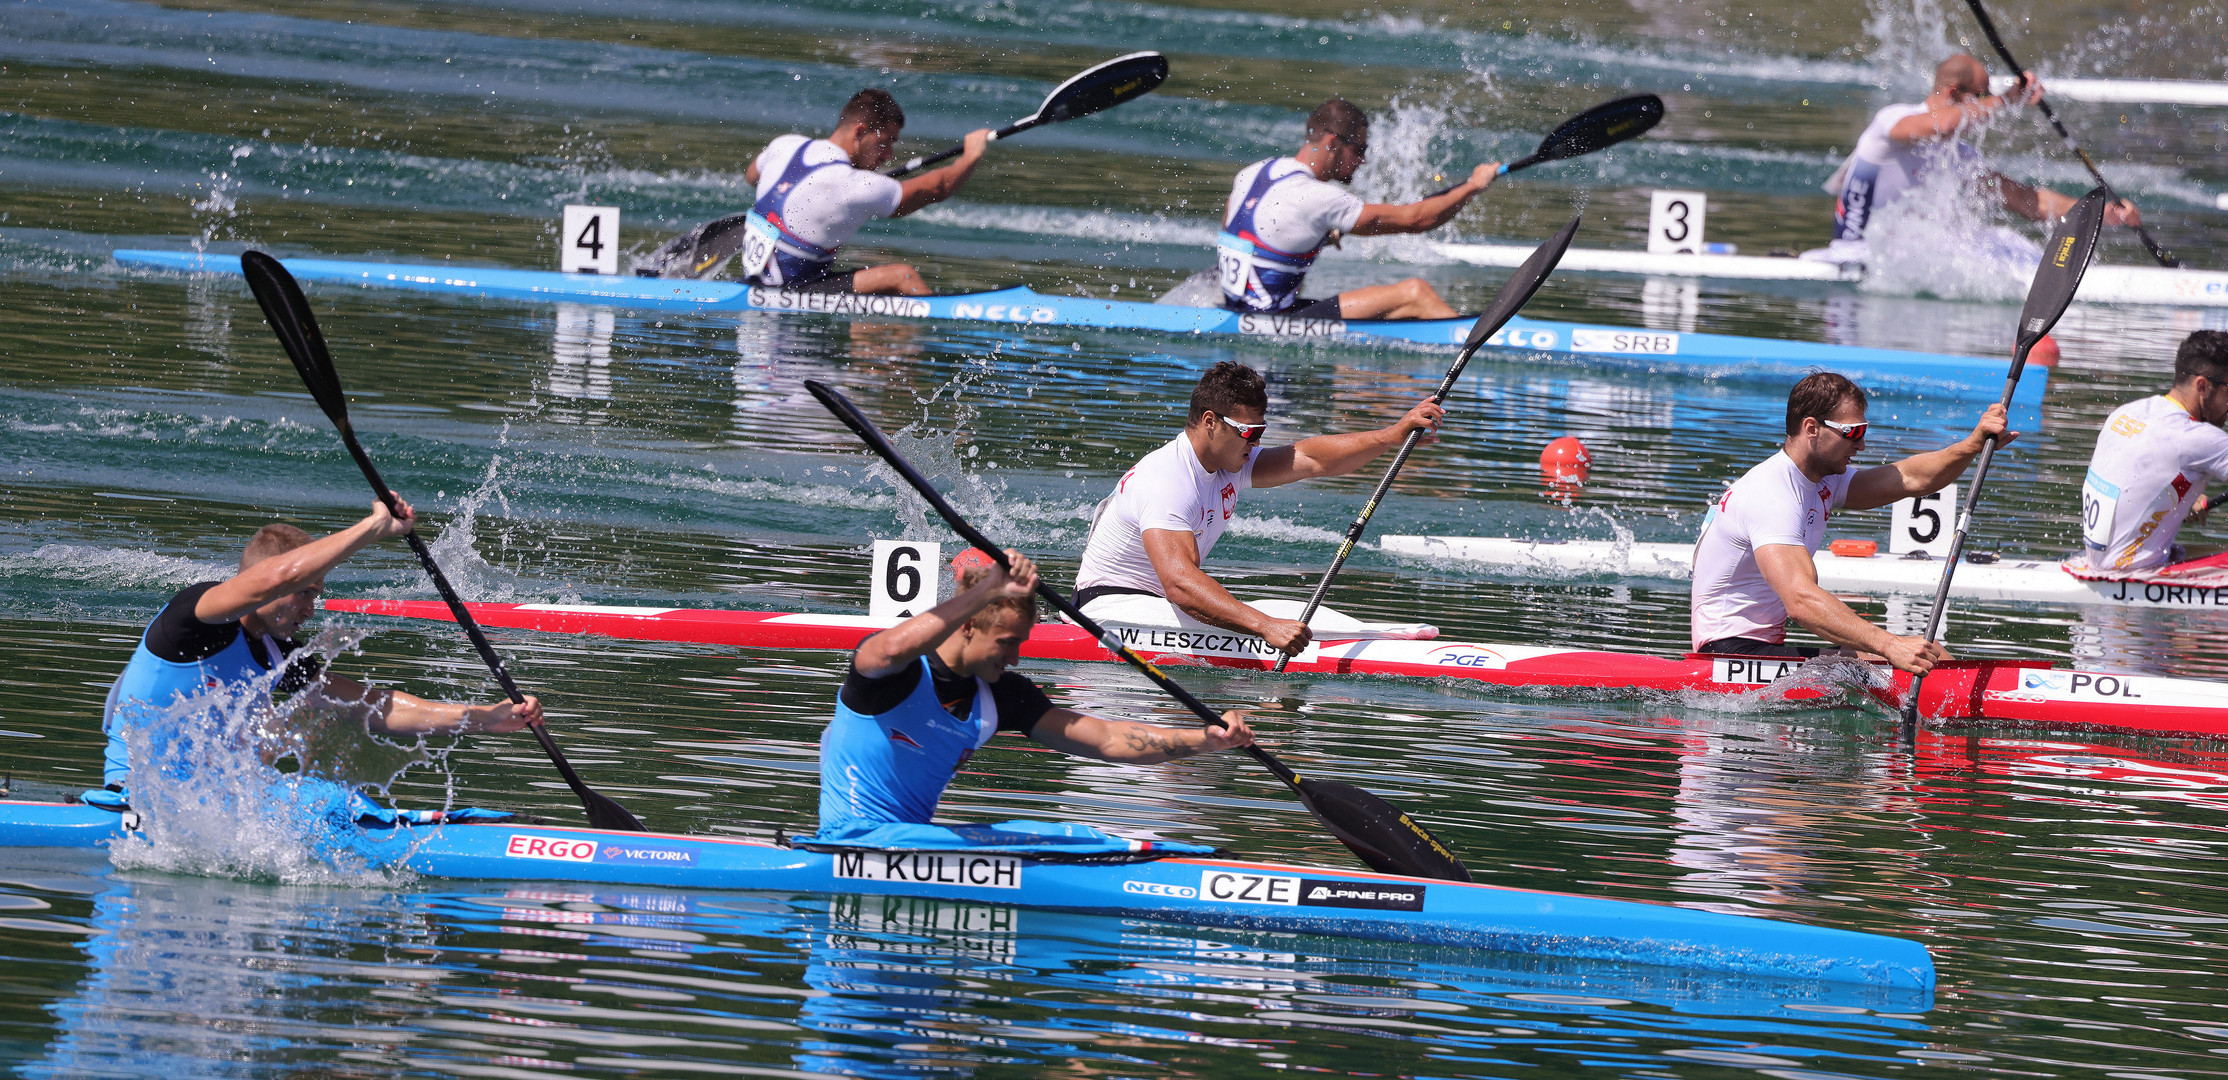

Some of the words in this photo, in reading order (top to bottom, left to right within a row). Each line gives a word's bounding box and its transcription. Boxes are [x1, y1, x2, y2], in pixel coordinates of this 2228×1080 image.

[1664, 200, 1689, 241] 3
[1842, 181, 1870, 240] RANCE
[577, 215, 604, 260] 4
[751, 287, 771, 306] S.
[779, 288, 926, 318] STEFANOVIC
[955, 302, 1056, 323] NELO
[1242, 314, 1262, 333] S.
[1272, 315, 1343, 337] VEKIC
[1613, 334, 1670, 352] SRB
[2111, 414, 2147, 438] ESP
[1908, 492, 1941, 544] 5
[886, 546, 921, 603] 6
[2113, 580, 2134, 601] J.
[2145, 584, 2228, 605] ORIYE
[1119, 628, 1143, 645] W.
[1151, 630, 1277, 655] LESZCZYŃS
[1439, 653, 1489, 667] PGE
[1728, 659, 1804, 684] PILA
[1984, 690, 2043, 702] NELO
[2071, 673, 2141, 698] POL
[508, 837, 594, 859] ERGO
[624, 849, 691, 861] VICTORIA
[839, 853, 872, 878] M.
[886, 853, 1016, 886] KULICH
[1127, 881, 1195, 898] NELO
[1210, 873, 1290, 903] CZE
[1307, 886, 1376, 901] ALPINE
[1378, 892, 1415, 902] PRO
